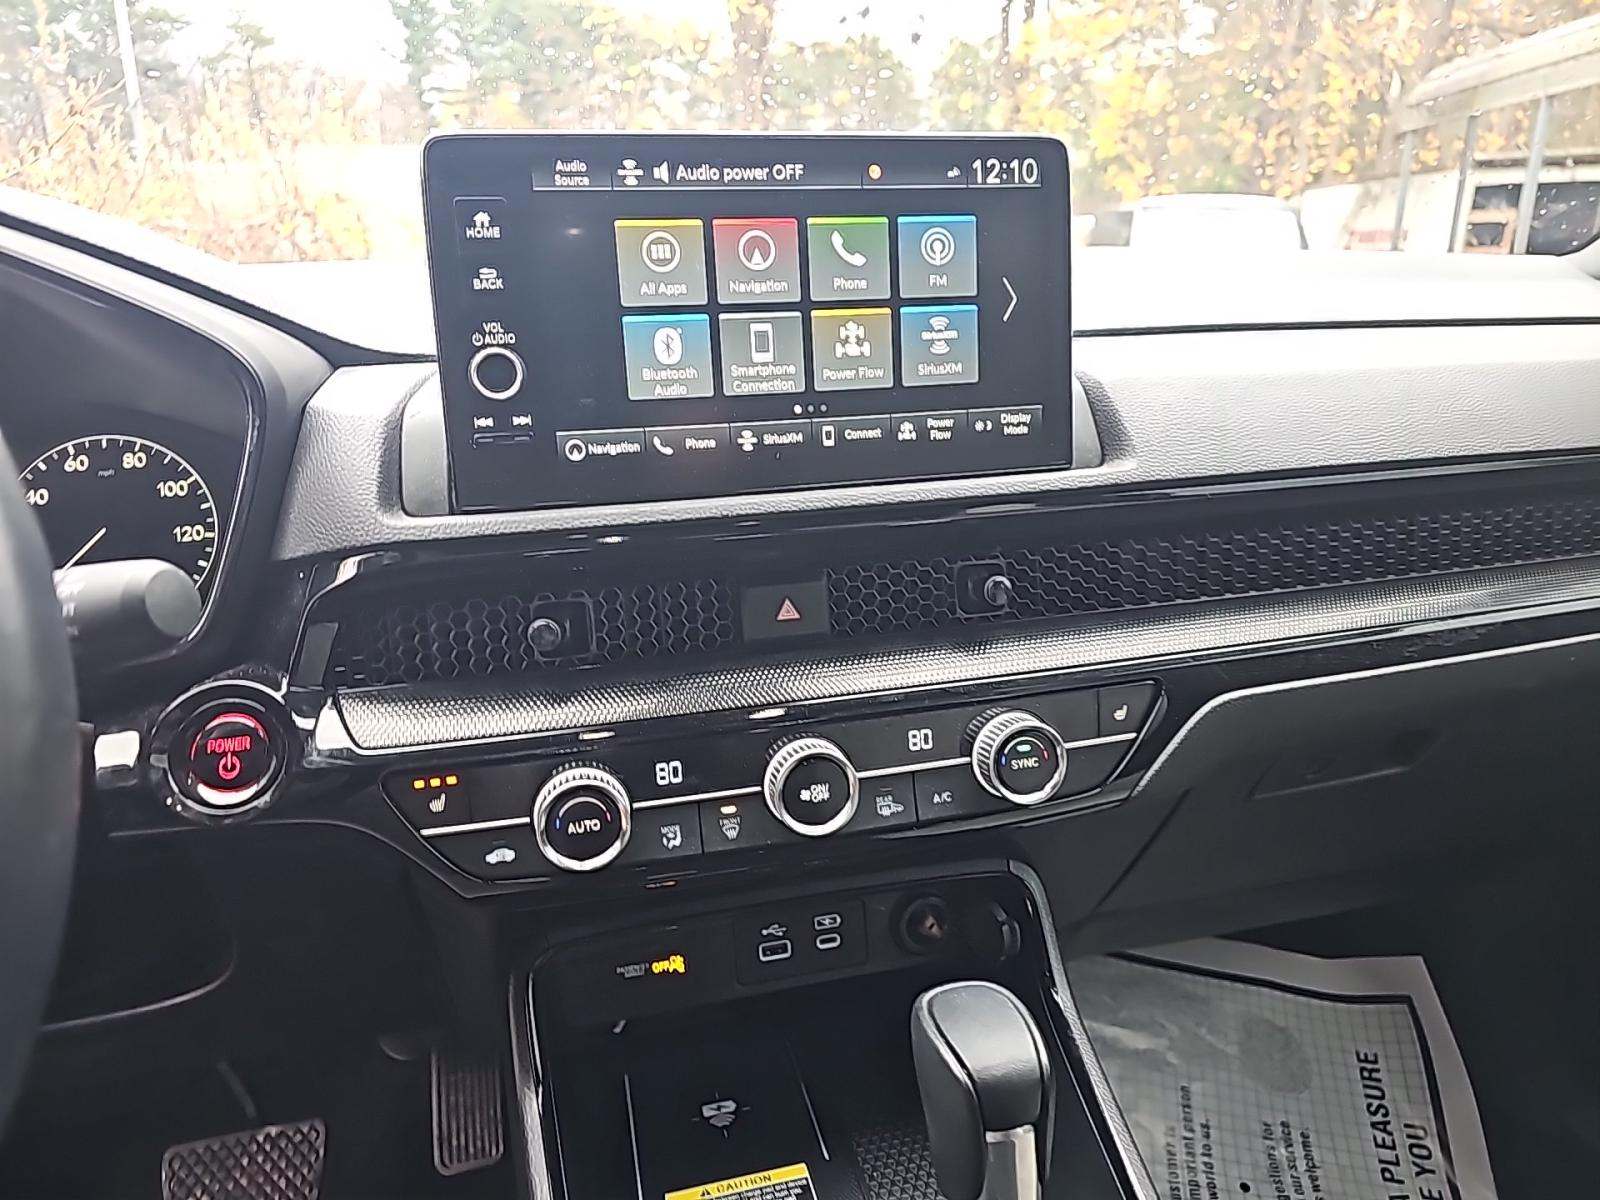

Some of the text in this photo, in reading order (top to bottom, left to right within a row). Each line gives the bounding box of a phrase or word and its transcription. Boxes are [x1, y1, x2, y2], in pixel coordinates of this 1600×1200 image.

[555, 159, 587, 172] Audio
[676, 163, 805, 183] Audio power OFF
[971, 157, 1039, 184] 12:10
[554, 174, 590, 186] Source
[465, 226, 501, 239] HOME
[473, 278, 504, 290] BACK
[729, 279, 788, 295] Navigation
[833, 277, 868, 291] Phone
[929, 274, 948, 287] FM
[640, 281, 688, 297] All Apps
[482, 321, 504, 333] VOL
[484, 332, 516, 345] AUDIO
[642, 366, 699, 381] Bluetooth
[731, 363, 796, 379] Smartphone
[822, 366, 885, 381] Power Flow
[917, 362, 963, 377] SiriusXM
[654, 383, 688, 397] Audio
[732, 378, 796, 393] Connection
[927, 417, 955, 430] Power
[1000, 412, 1032, 426] Display
[844, 427, 882, 441] Connect
[929, 429, 952, 442] Flow
[1003, 424, 1029, 437] Mode
[685, 437, 717, 450] Phone
[763, 432, 804, 446] SiriusXM
[588, 440, 641, 457] Navigation
[63, 454, 89, 472] 60
[122, 451, 147, 469] 80
[156, 480, 188, 498] 100
[172, 525, 205, 543] 120
[207, 736, 251, 754] POWER
[908, 729, 934, 751] 80
[1010, 757, 1040, 770] SYNC
[655, 760, 683, 786] 80
[933, 791, 953, 805] A/C
[567, 819, 601, 836] AUTO
[1355, 1050, 1405, 1185] PLEASURE
[1180, 1085, 1201, 1200] mportant person
[1280, 1120, 1298, 1171] service
[1403, 1122, 1437, 1177] YOU
[1200, 1143, 1212, 1159] to
[1262, 1121, 1291, 1200] gestions for
[1165, 1142, 1181, 1200] ustomer
[716, 1173, 772, 1193] CAUTION
[1202, 1160, 1219, 1200] world
[1290, 1173, 1306, 1196] our
